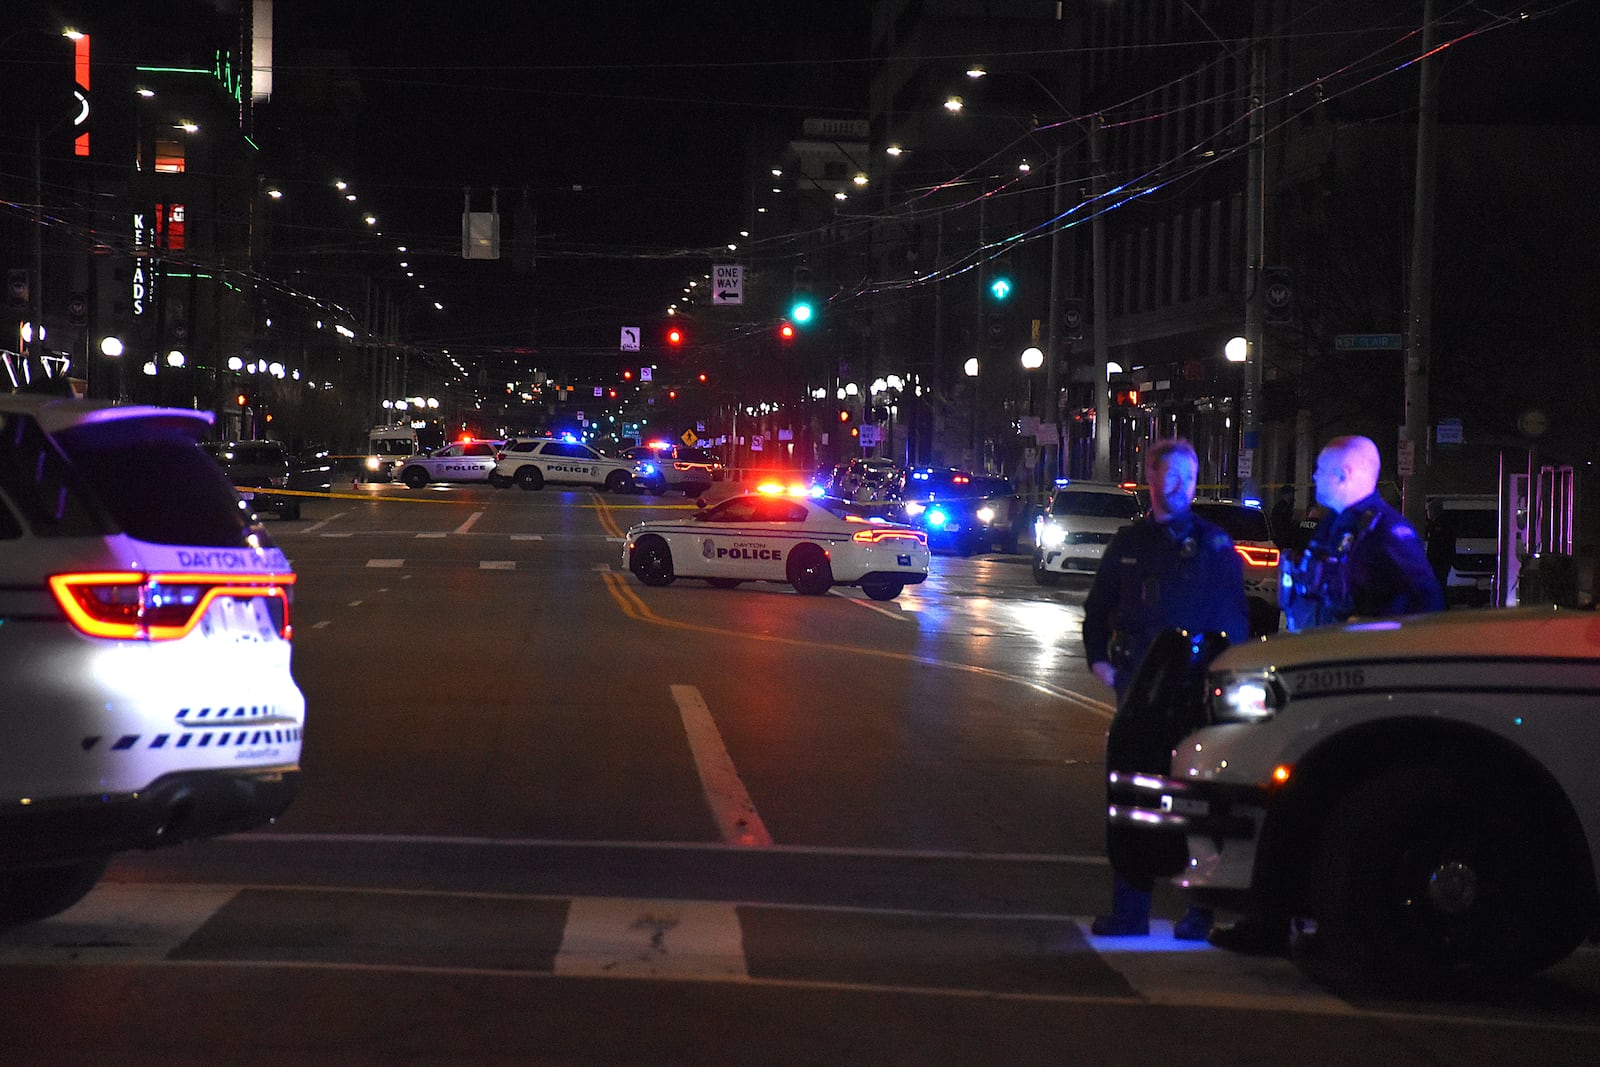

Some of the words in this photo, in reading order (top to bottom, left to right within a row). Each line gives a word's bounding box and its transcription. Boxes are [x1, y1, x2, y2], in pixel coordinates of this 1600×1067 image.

[717, 267, 739, 278] ONE
[717, 279, 739, 288] WAY
[547, 465, 589, 473] POLICE
[176, 550, 246, 569] DAYTON
[717, 548, 782, 560] POLICE
[1296, 669, 1365, 690] 230116
